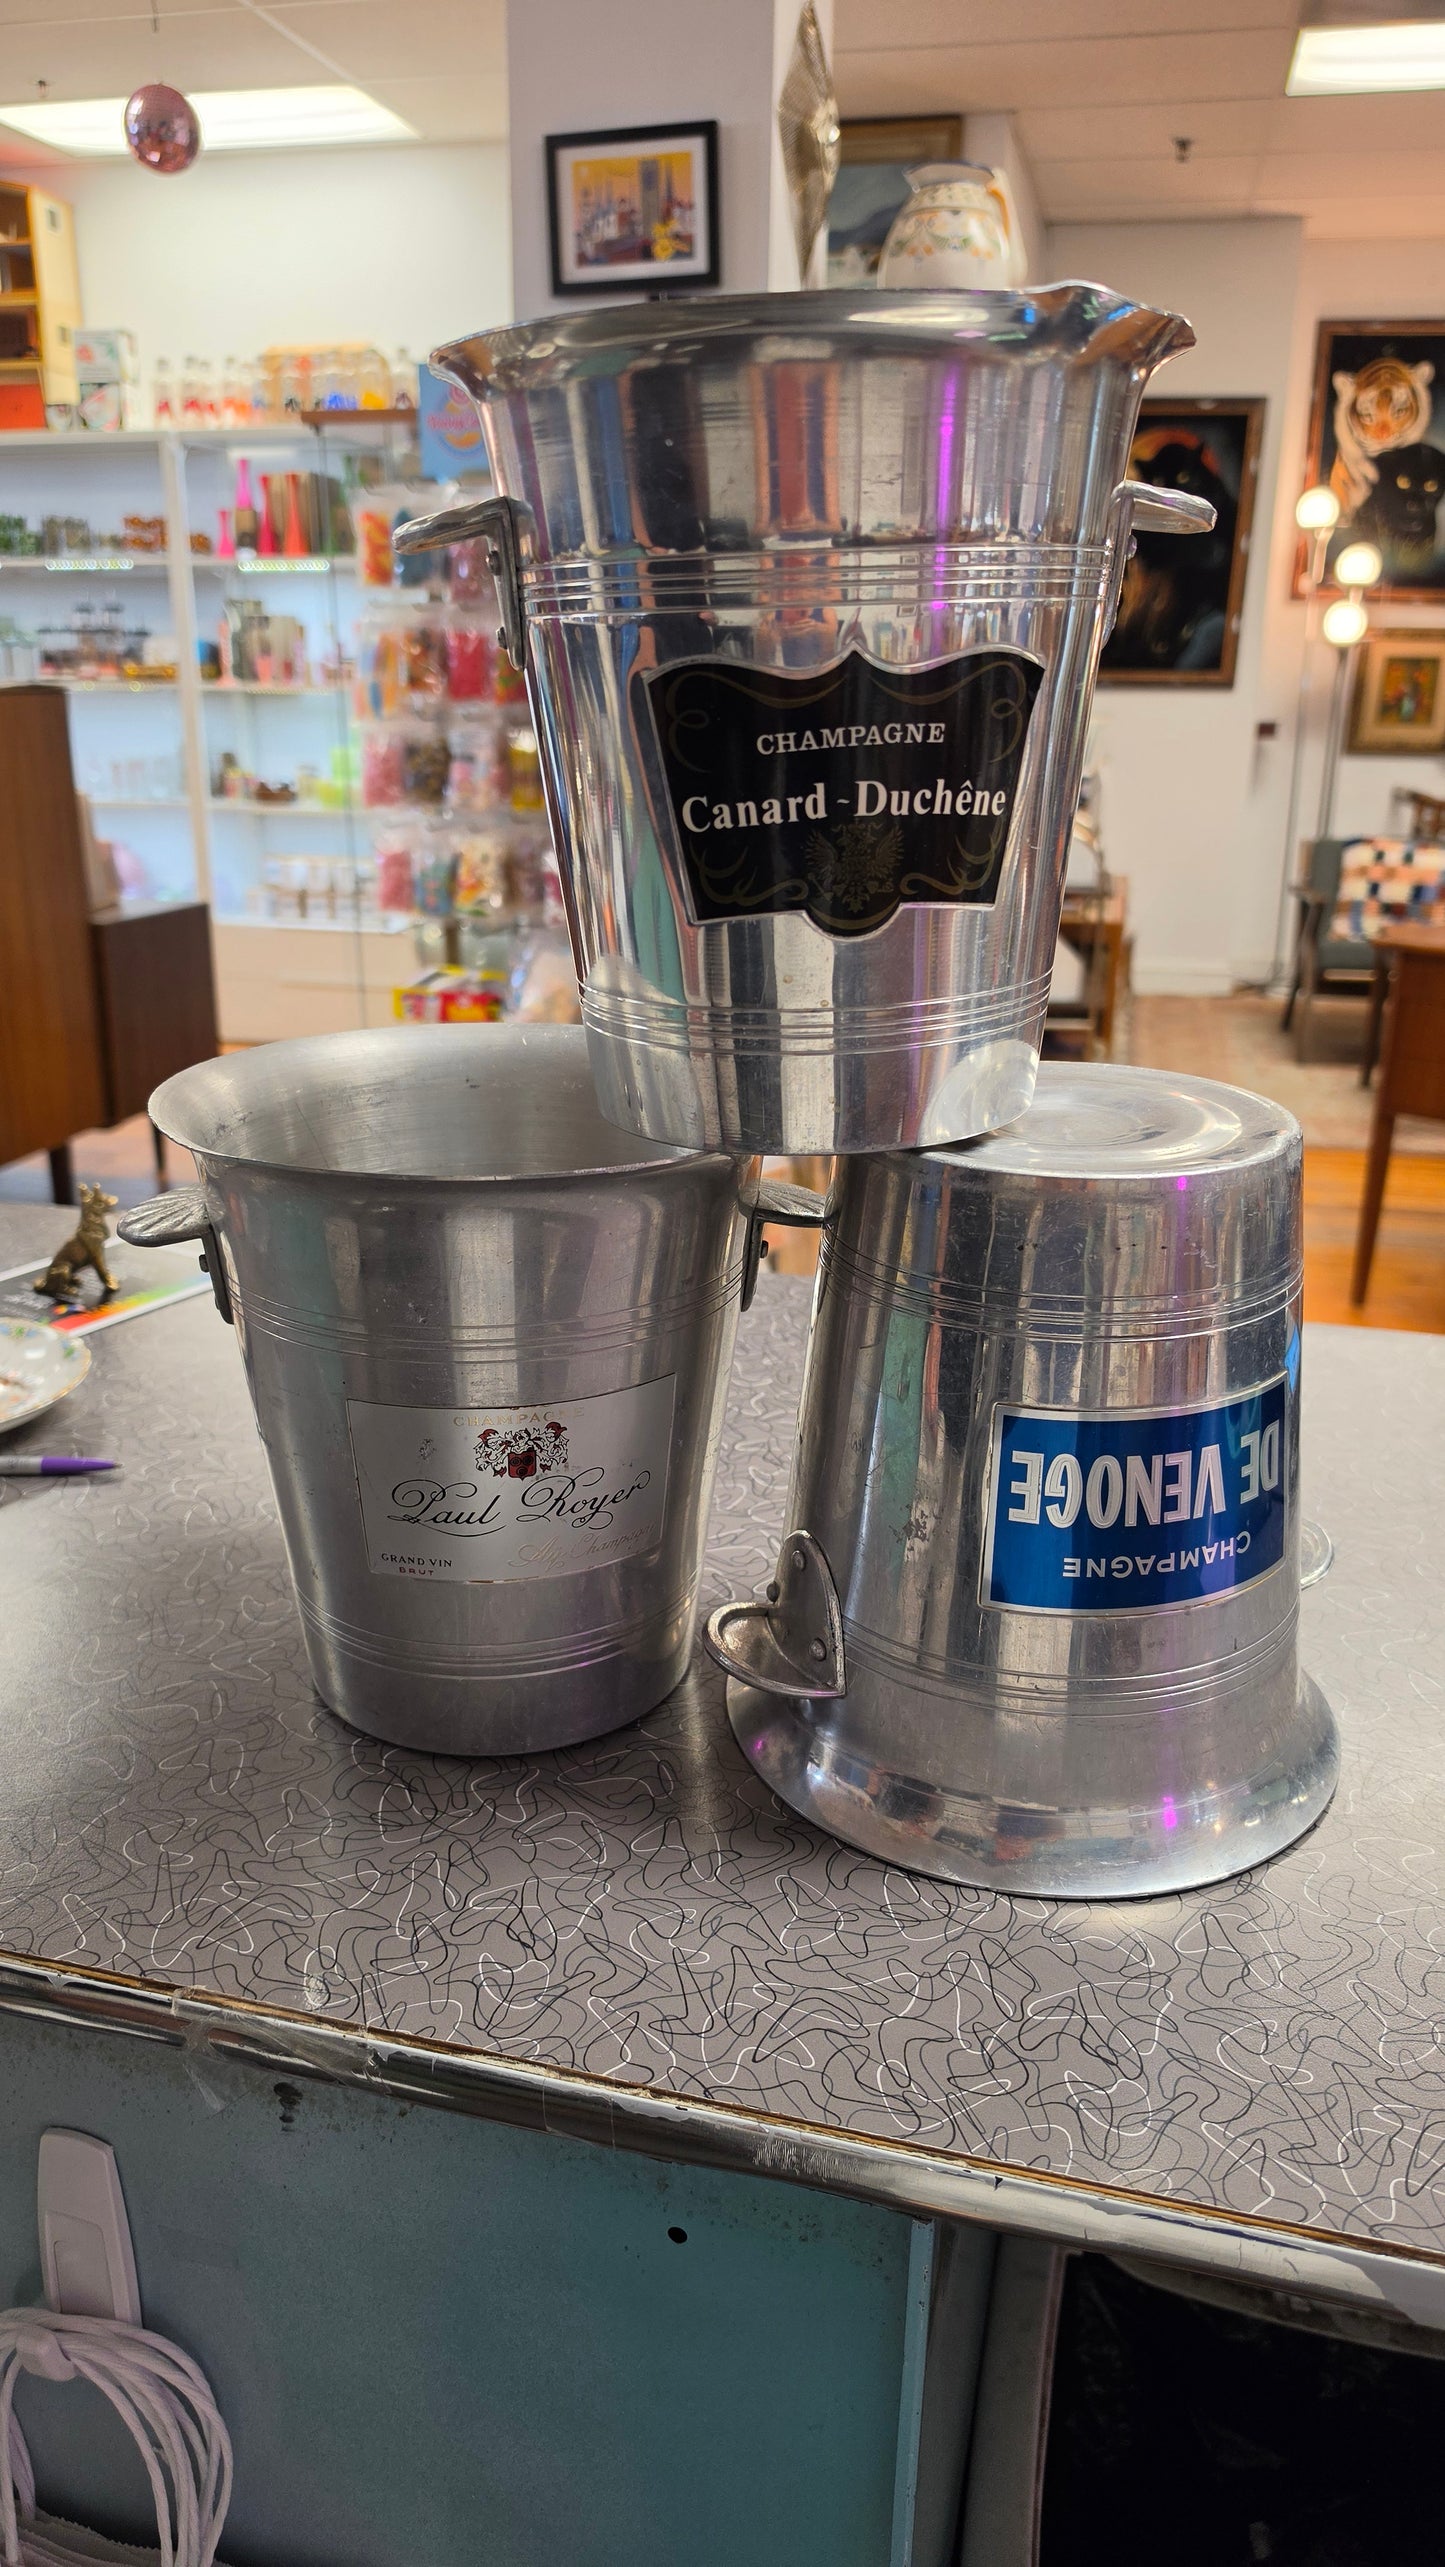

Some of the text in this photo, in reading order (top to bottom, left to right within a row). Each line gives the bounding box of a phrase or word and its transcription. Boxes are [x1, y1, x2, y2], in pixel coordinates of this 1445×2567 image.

[756, 722, 946, 755] CHAMPAGNE
[681, 782, 828, 834] Canard
[853, 778, 1007, 817] Duchêne
[453, 1406, 585, 1427] CHAMPAGNE
[1008, 1418, 1280, 1529] DE VENOGE
[387, 1466, 651, 1537] Paul Royer
[381, 1553, 452, 1568] GRAND VIN
[399, 1566, 434, 1576] BRUT
[1062, 1530, 1251, 1578] CHAMPAGNE
